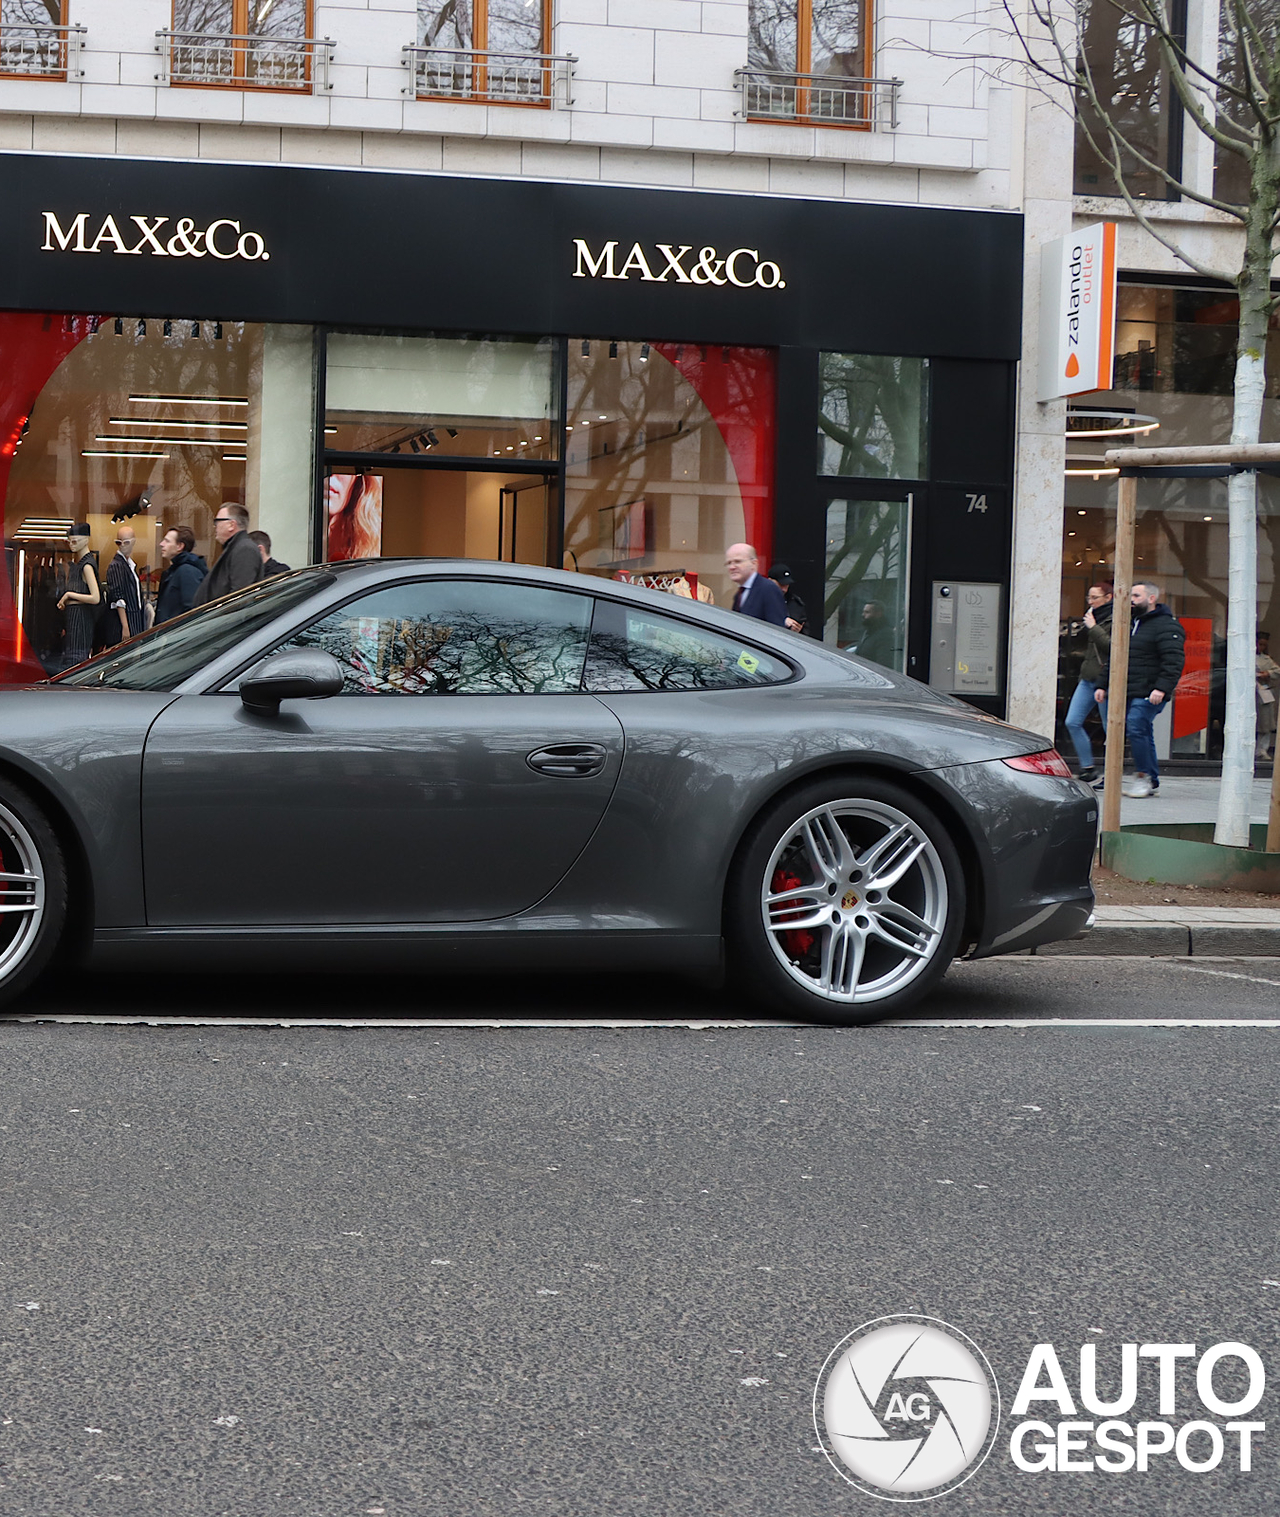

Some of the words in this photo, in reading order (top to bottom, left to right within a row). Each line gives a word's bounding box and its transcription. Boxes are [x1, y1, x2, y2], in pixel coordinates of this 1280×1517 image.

[40, 211, 270, 261] MAX&Co.
[572, 238, 786, 289] MAX&Co.
[1083, 243, 1094, 304] outlet
[1067, 246, 1083, 348] zalando
[965, 493, 988, 513] 74
